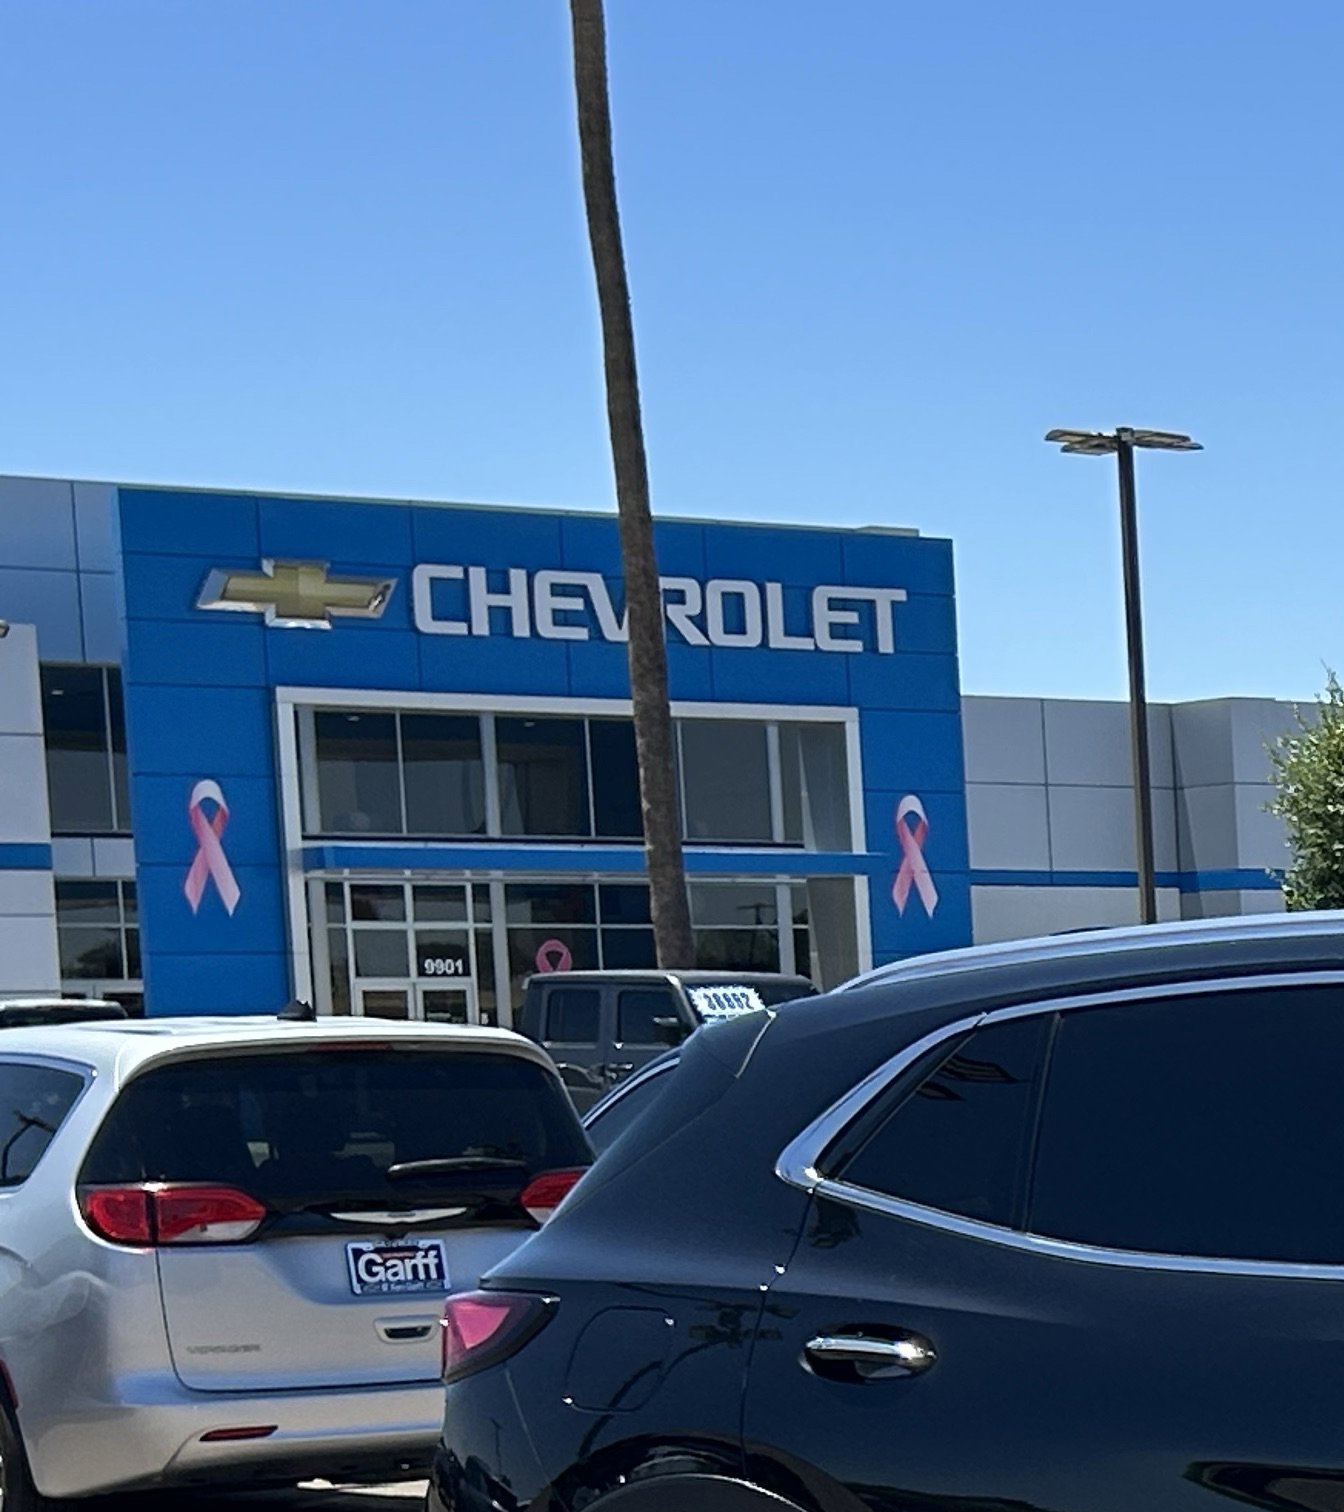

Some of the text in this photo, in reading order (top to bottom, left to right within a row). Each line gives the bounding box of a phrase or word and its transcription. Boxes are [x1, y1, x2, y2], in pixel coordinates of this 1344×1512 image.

[411, 563, 908, 655] CHEVROLET
[424, 958, 464, 975] 9901
[358, 1250, 439, 1283] Garff
